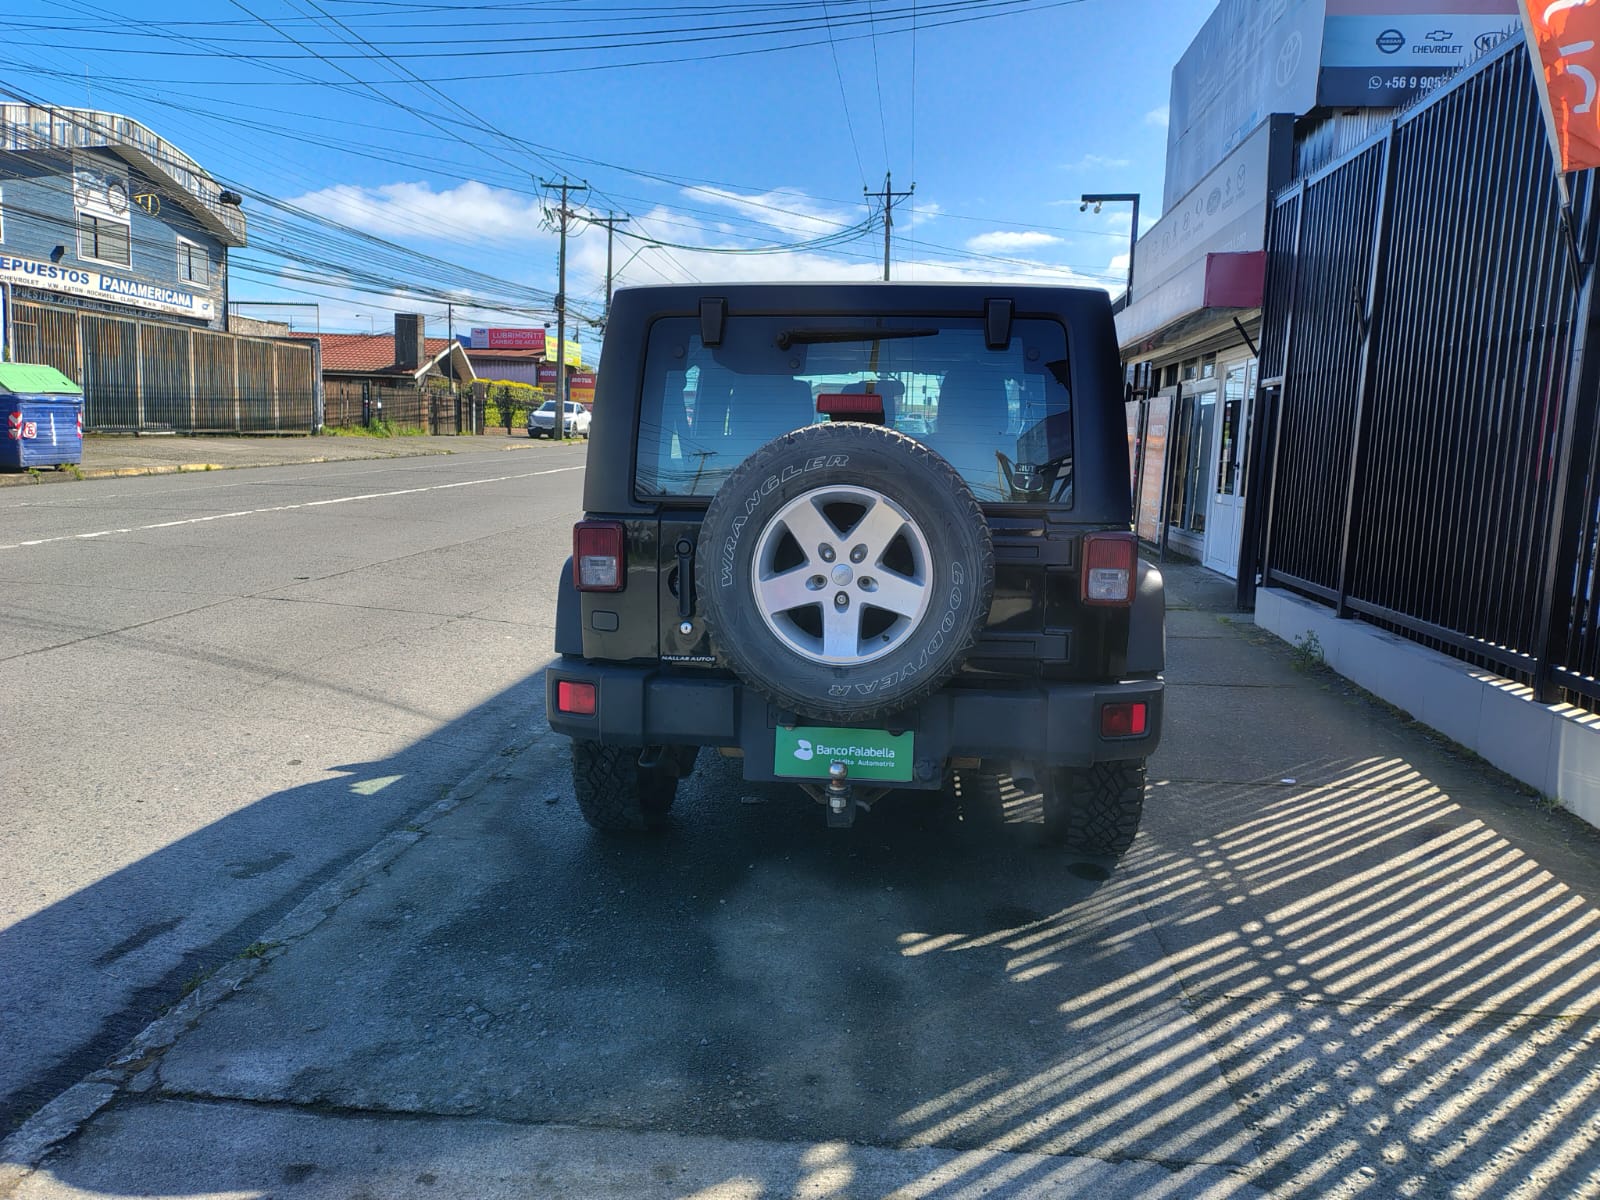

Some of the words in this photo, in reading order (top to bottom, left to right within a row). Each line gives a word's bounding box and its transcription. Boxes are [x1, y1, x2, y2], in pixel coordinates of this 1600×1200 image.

[1412, 45, 1464, 54] CHEVROLET
[1385, 76, 1406, 89] +56
[1409, 76, 1417, 89] 9
[0, 274, 40, 285] CHEVROLET
[102, 276, 192, 308] PANAMERICANA
[722, 454, 850, 588] WRANGLER
[829, 561, 965, 697] GOODYEAR
